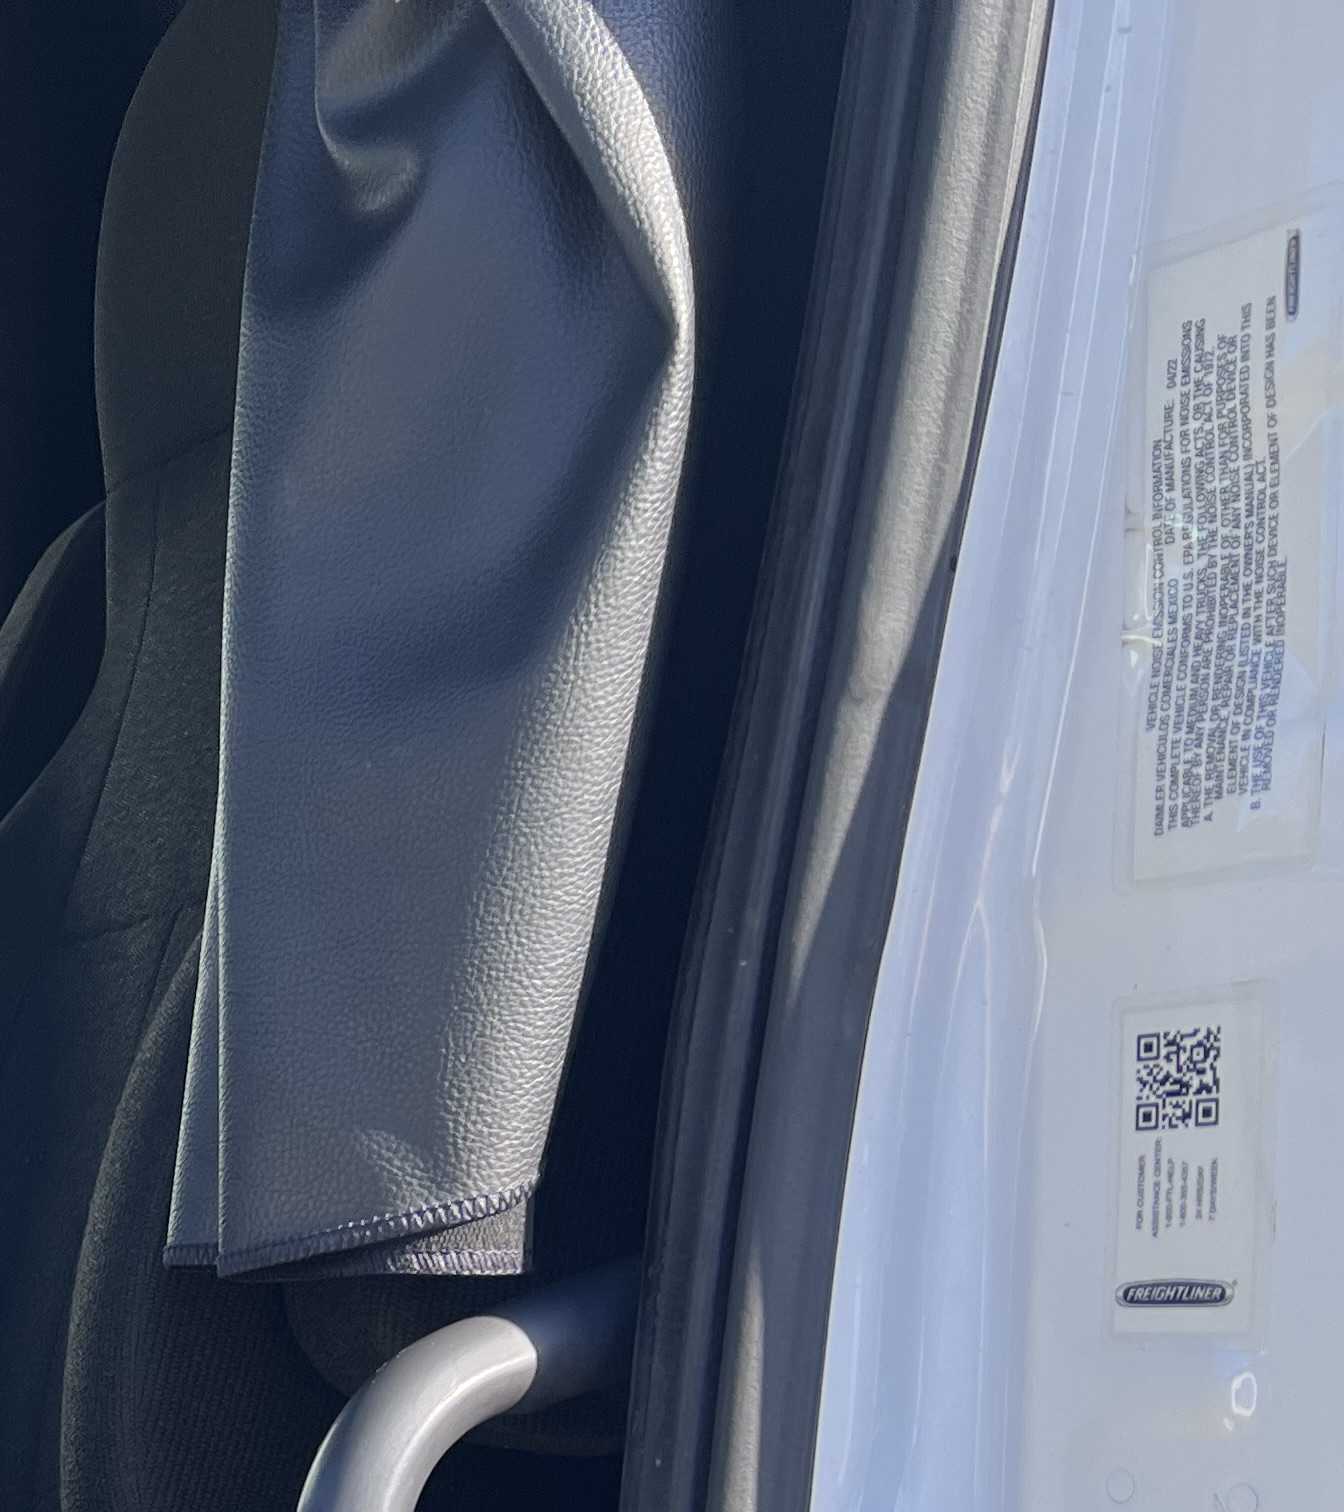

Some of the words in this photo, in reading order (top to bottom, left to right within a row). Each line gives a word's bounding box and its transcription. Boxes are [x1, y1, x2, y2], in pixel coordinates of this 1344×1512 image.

[1166, 359, 1177, 389] 04/22
[1182, 320, 1193, 386] EMISSIONS
[1180, 390, 1191, 424] NOISE
[1180, 429, 1191, 453] FOR
[1152, 440, 1162, 520] INFORMATION
[1165, 496, 1175, 511] OF
[1165, 514, 1176, 544] DATE
[1255, 487, 1266, 543] CONTROL
[1152, 524, 1163, 580] CONTROL
[1183, 543, 1193, 565] EPA
[1254, 547, 1264, 583] NOISE
[1168, 579, 1178, 624] MEXICO
[1182, 594, 1193, 609] TO
[1253, 589, 1264, 611] THE
[1177, 613, 1193, 681] CONFORMS
[1252, 614, 1263, 645] WITH
[1150, 643, 1162, 678] NOISE
[1160, 628, 1177, 711] COMERCIALES
[1146, 682, 1160, 731] VEHICLE
[1173, 684, 1185, 734] VEHICLE
[1244, 647, 1261, 725] COMPLIANCE
[1156, 714, 1170, 780] VEHICULOS
[1242, 729, 1252, 741] IN
[1169, 737, 1182, 801] COMPLETE
[1239, 746, 1250, 795] VEHICLE
[1154, 785, 1166, 836] DAIMLER
[1168, 804, 1178, 831] THIS
[1137, 1154, 1145, 1208] CUSTOMER
[1152, 1180, 1160, 1238] ASSISTANCE
[1126, 1286, 1223, 1302] FREIGHTLINER
